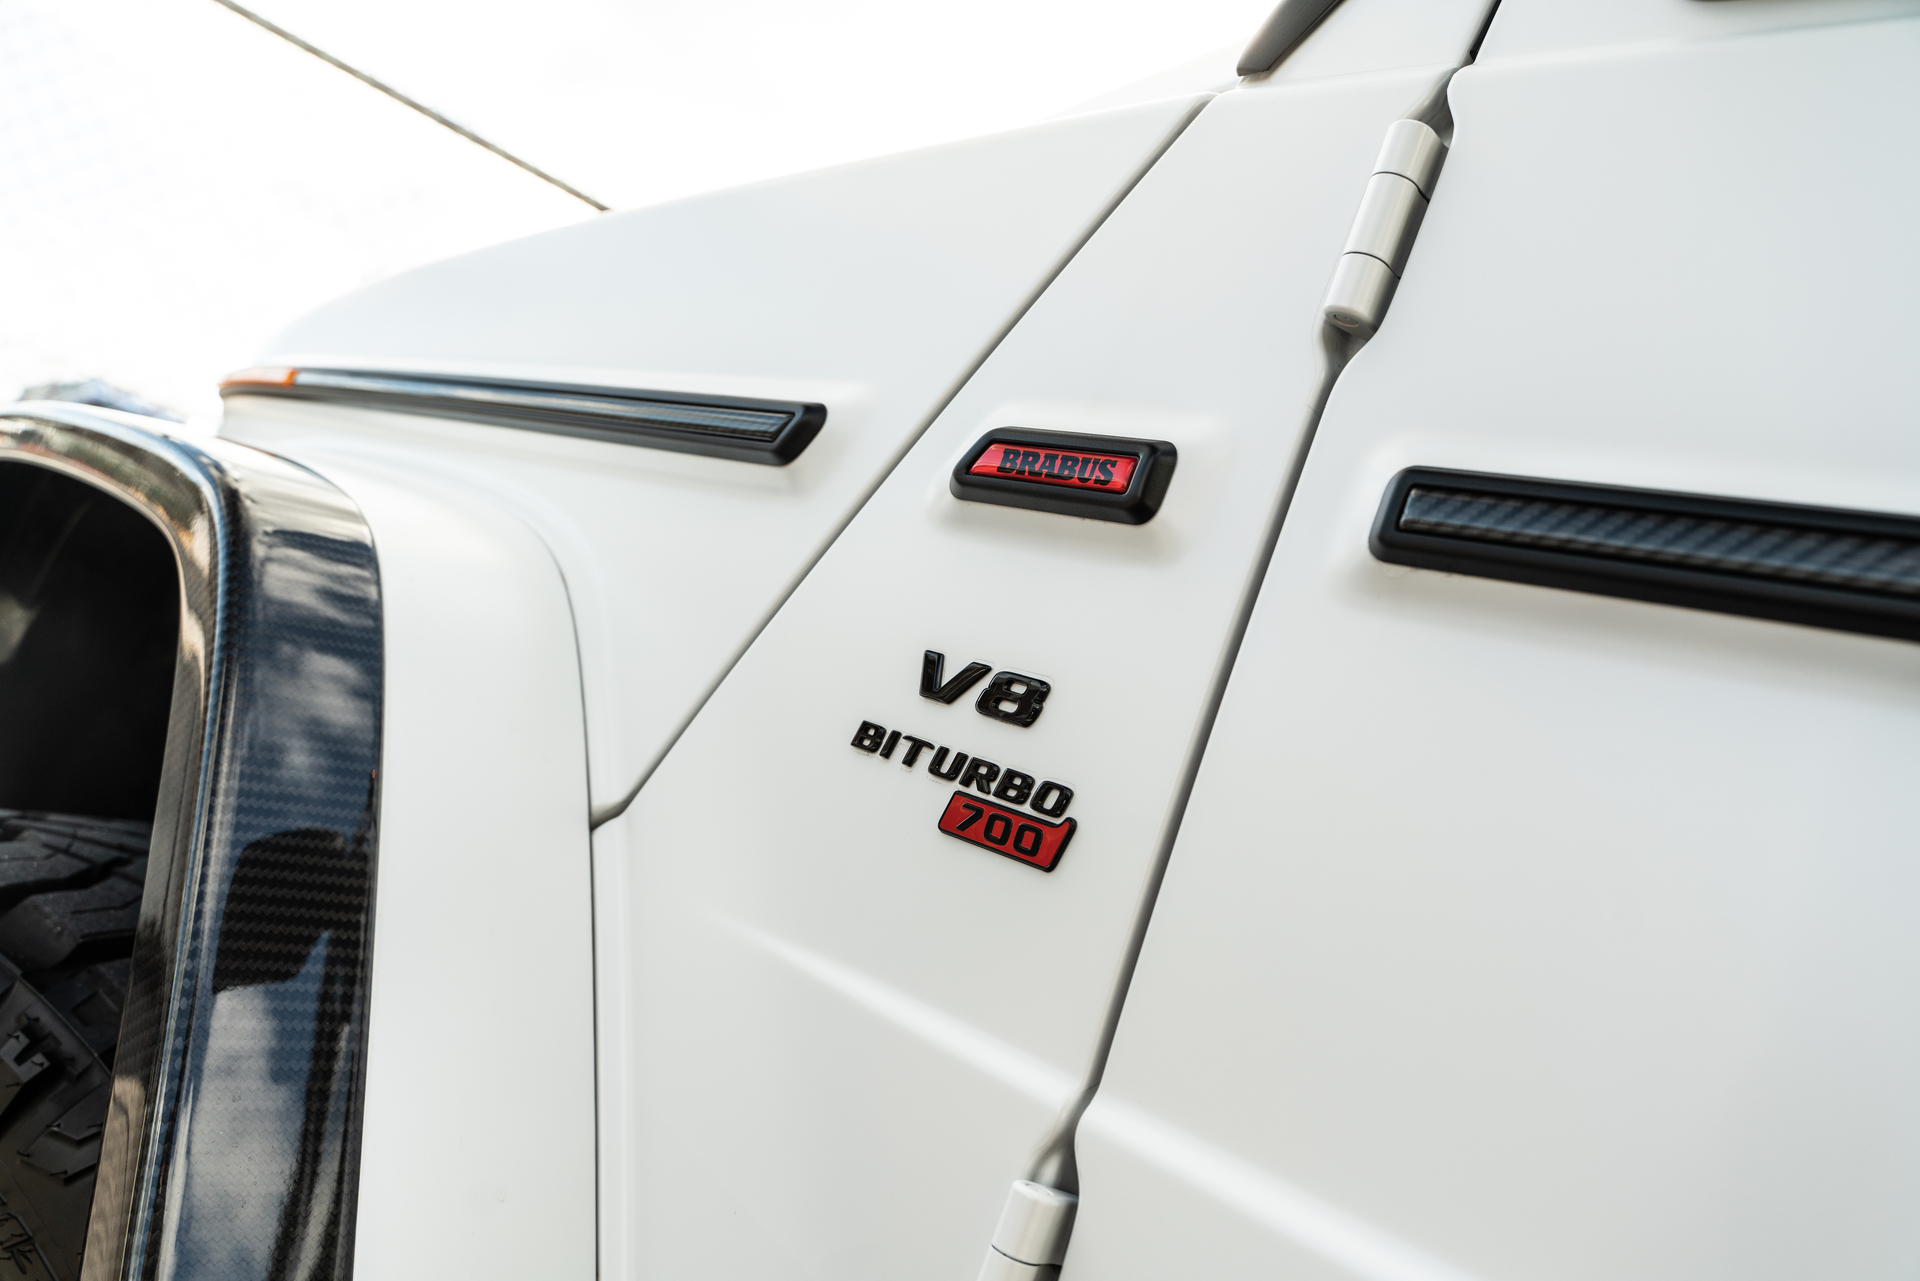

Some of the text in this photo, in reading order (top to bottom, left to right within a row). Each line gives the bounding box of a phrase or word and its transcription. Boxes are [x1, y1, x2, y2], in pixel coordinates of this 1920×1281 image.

[997, 448, 1117, 486] BRABUS
[919, 649, 1051, 728] V8
[850, 719, 1074, 818] BITURBO
[956, 802, 1043, 857] 700
